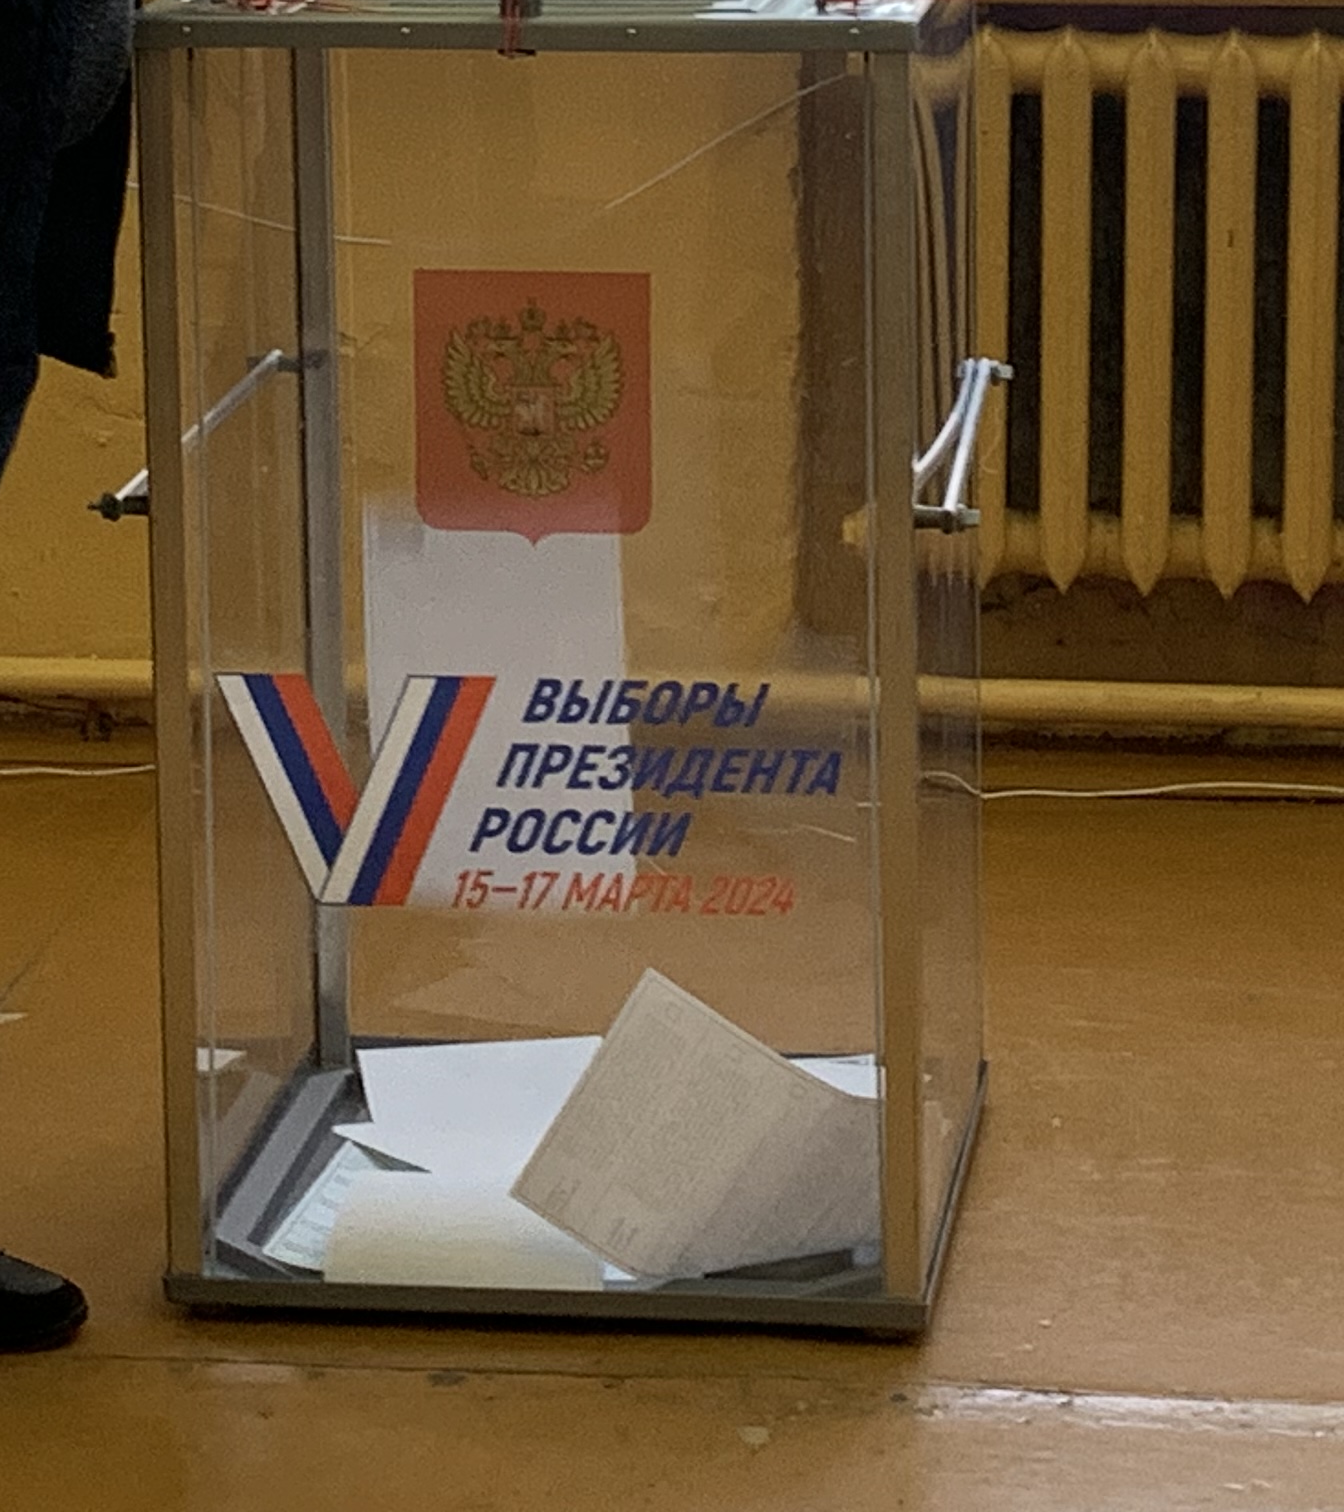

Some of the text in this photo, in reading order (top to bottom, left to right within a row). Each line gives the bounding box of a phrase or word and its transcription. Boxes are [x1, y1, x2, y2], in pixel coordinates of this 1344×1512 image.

[522, 678, 772, 728] ВЫБОРЫ
[496, 743, 843, 800] ПРЕЗИДЕНТА
[469, 807, 693, 856] РОССИИ
[561, 872, 695, 914] МАРТА
[700, 875, 797, 916] 2024
